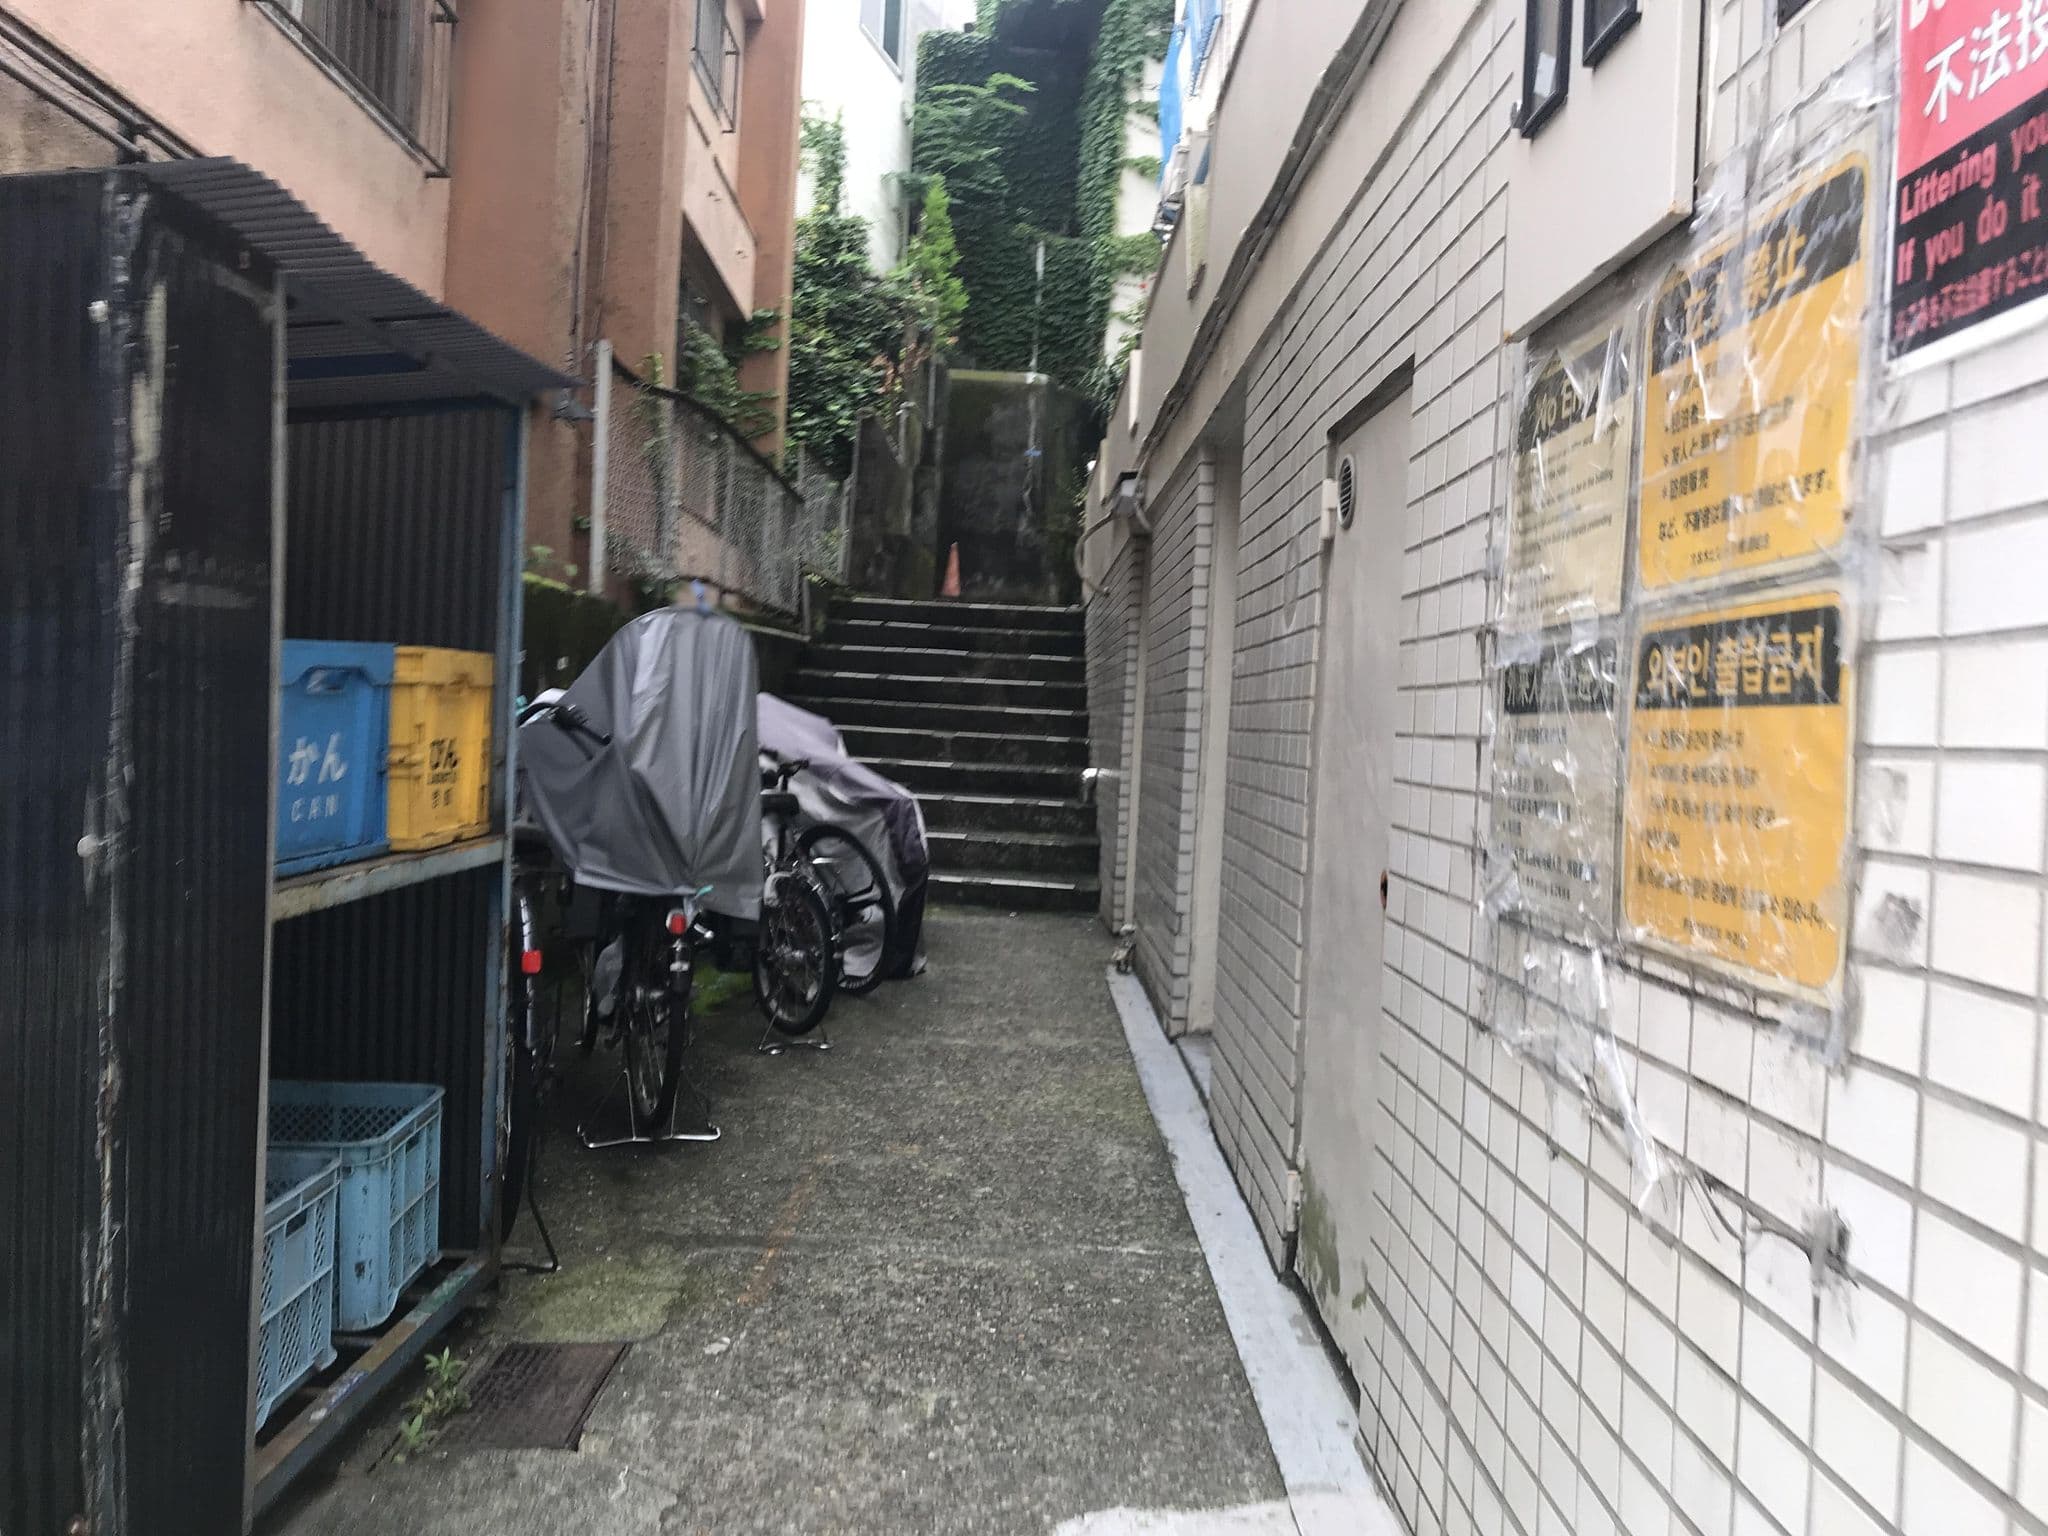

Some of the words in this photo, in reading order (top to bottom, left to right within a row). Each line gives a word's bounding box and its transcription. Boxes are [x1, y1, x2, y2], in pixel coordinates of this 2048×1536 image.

[1900, 142, 1997, 224] Littering
[1897, 236, 1916, 285] If
[1925, 220, 1964, 281] you
[1977, 193, 2008, 244] do
[2021, 172, 2042, 223] it
[287, 733, 348, 785] かん
[292, 795, 338, 822] CAN
